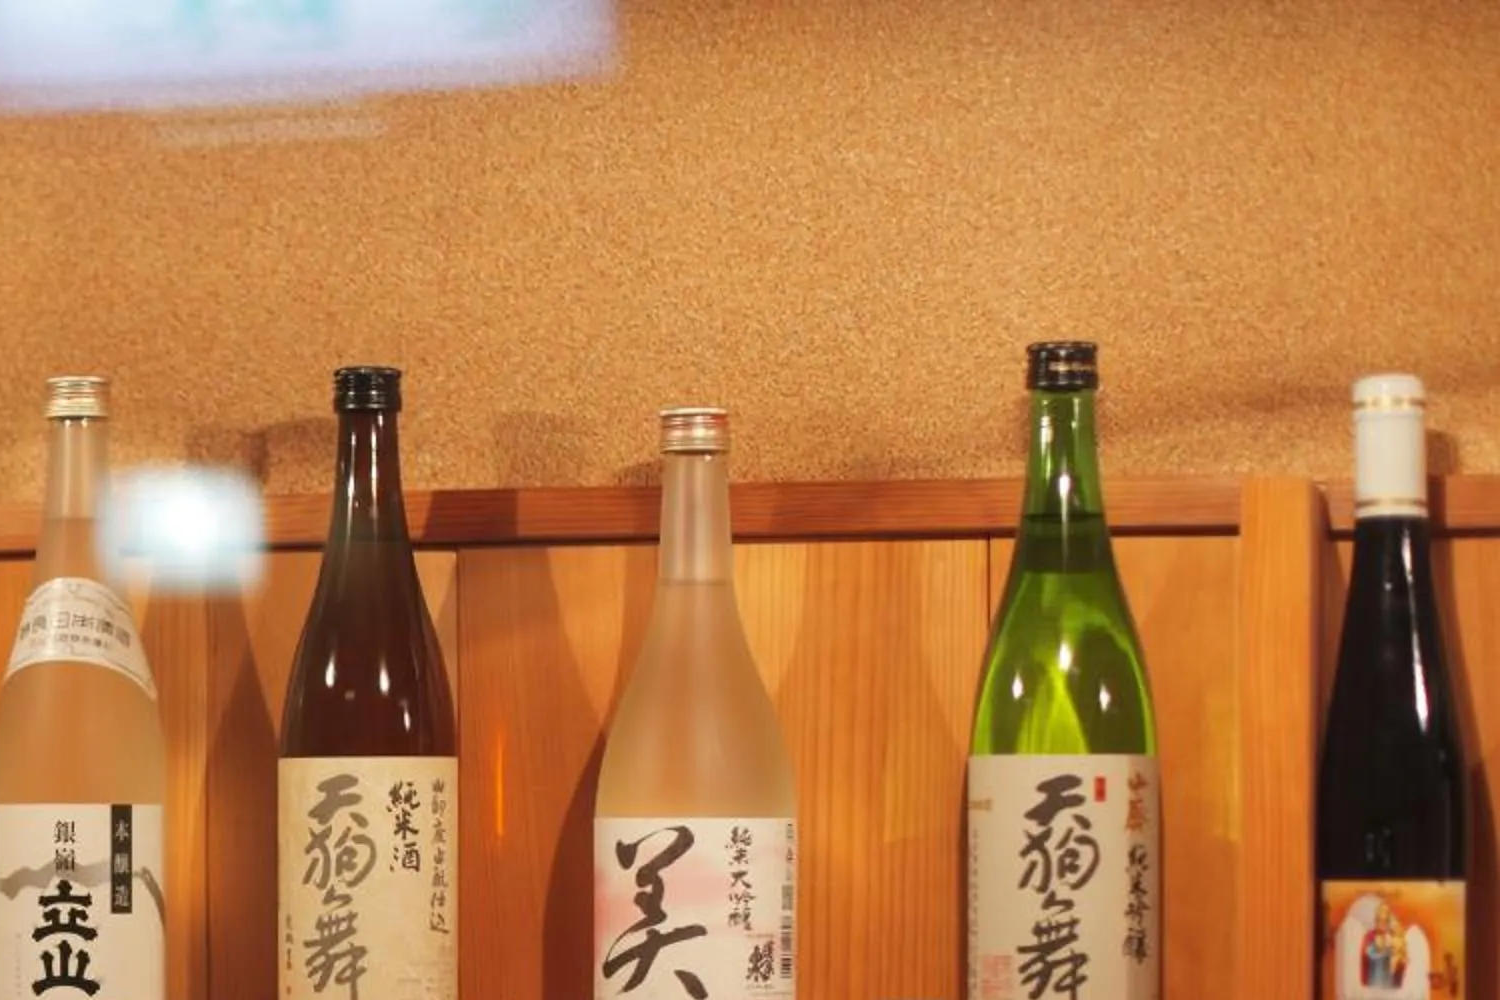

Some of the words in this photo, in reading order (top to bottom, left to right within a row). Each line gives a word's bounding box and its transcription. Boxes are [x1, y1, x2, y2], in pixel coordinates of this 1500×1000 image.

[386, 780, 420, 873] 純米酒
[32, 879, 101, 997] 立山
